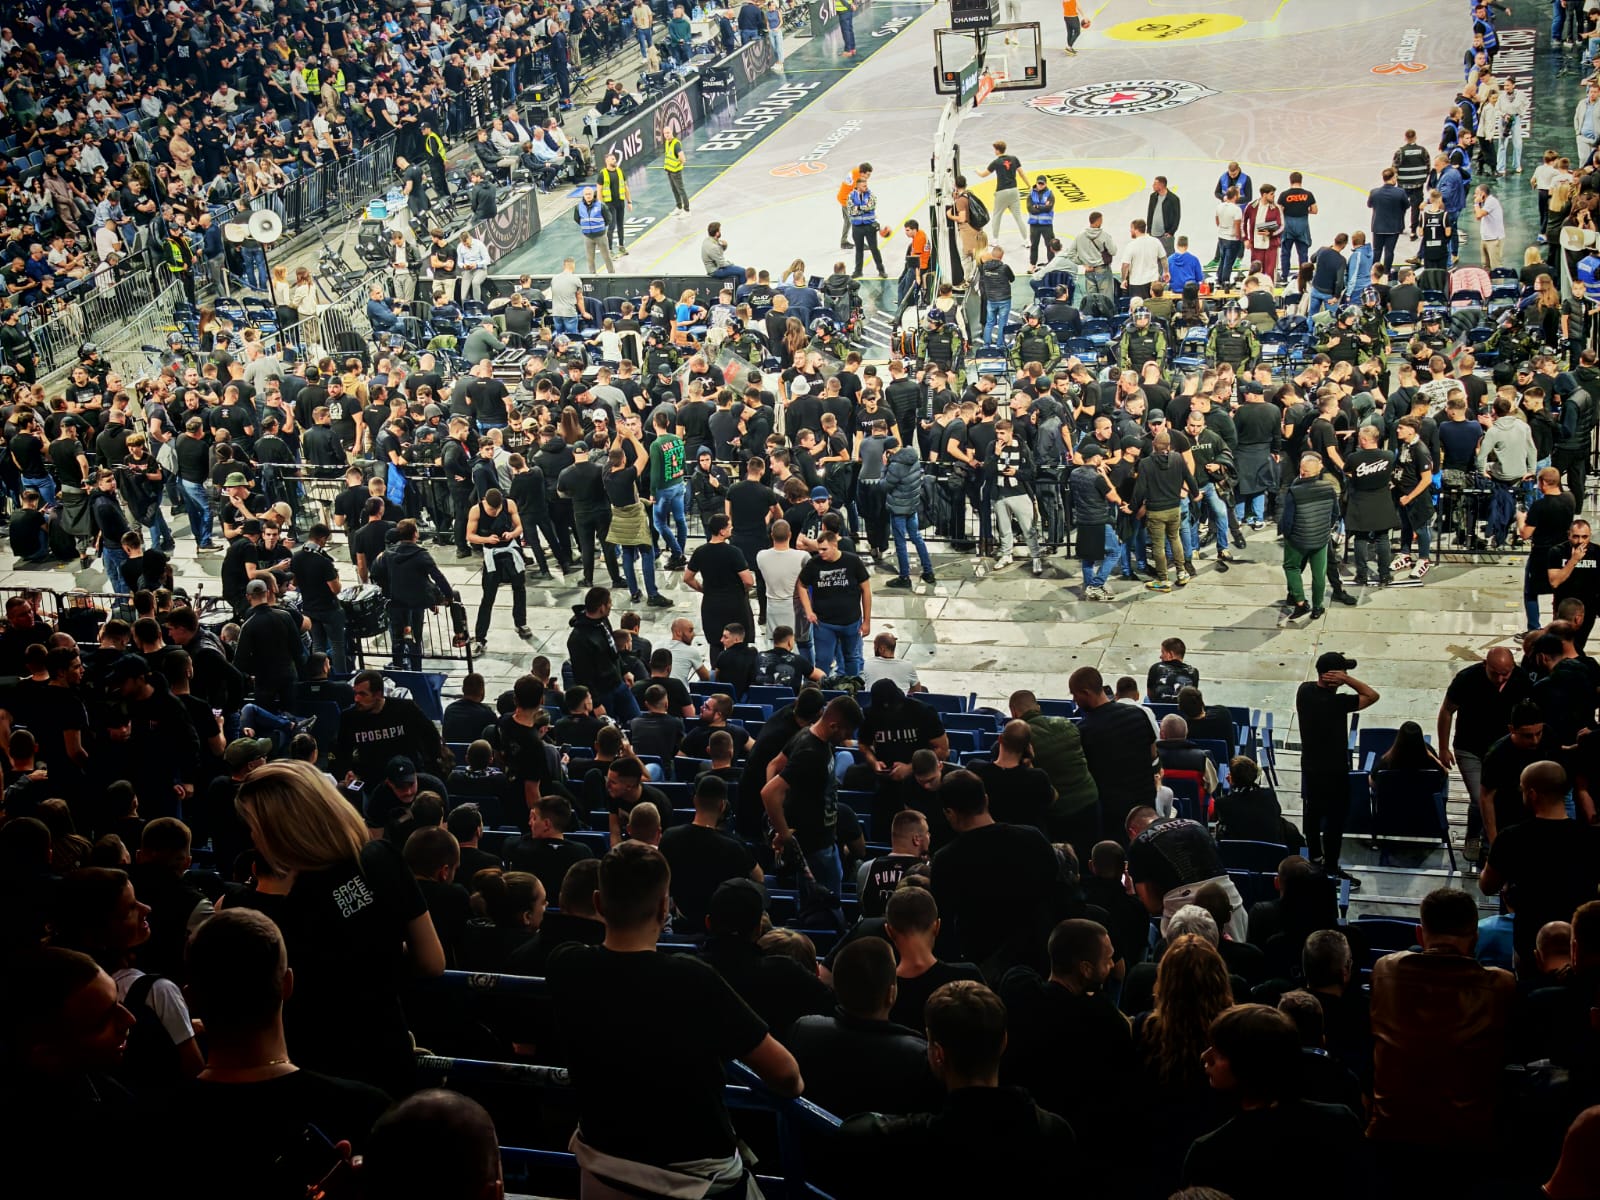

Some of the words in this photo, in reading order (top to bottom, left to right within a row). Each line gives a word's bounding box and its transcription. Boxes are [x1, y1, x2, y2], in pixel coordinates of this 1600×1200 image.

[953, 15, 989, 24] CHANGAN
[695, 81, 821, 151] BELGRADE
[623, 128, 643, 161] NIS
[1286, 193, 1308, 202] CREW
[1430, 226, 1436, 239] 1
[355, 725, 405, 743] ГРОБАРИ
[332, 874, 361, 901] SRCE
[336, 881, 369, 910] RUKE
[342, 893, 374, 919] GLAS
